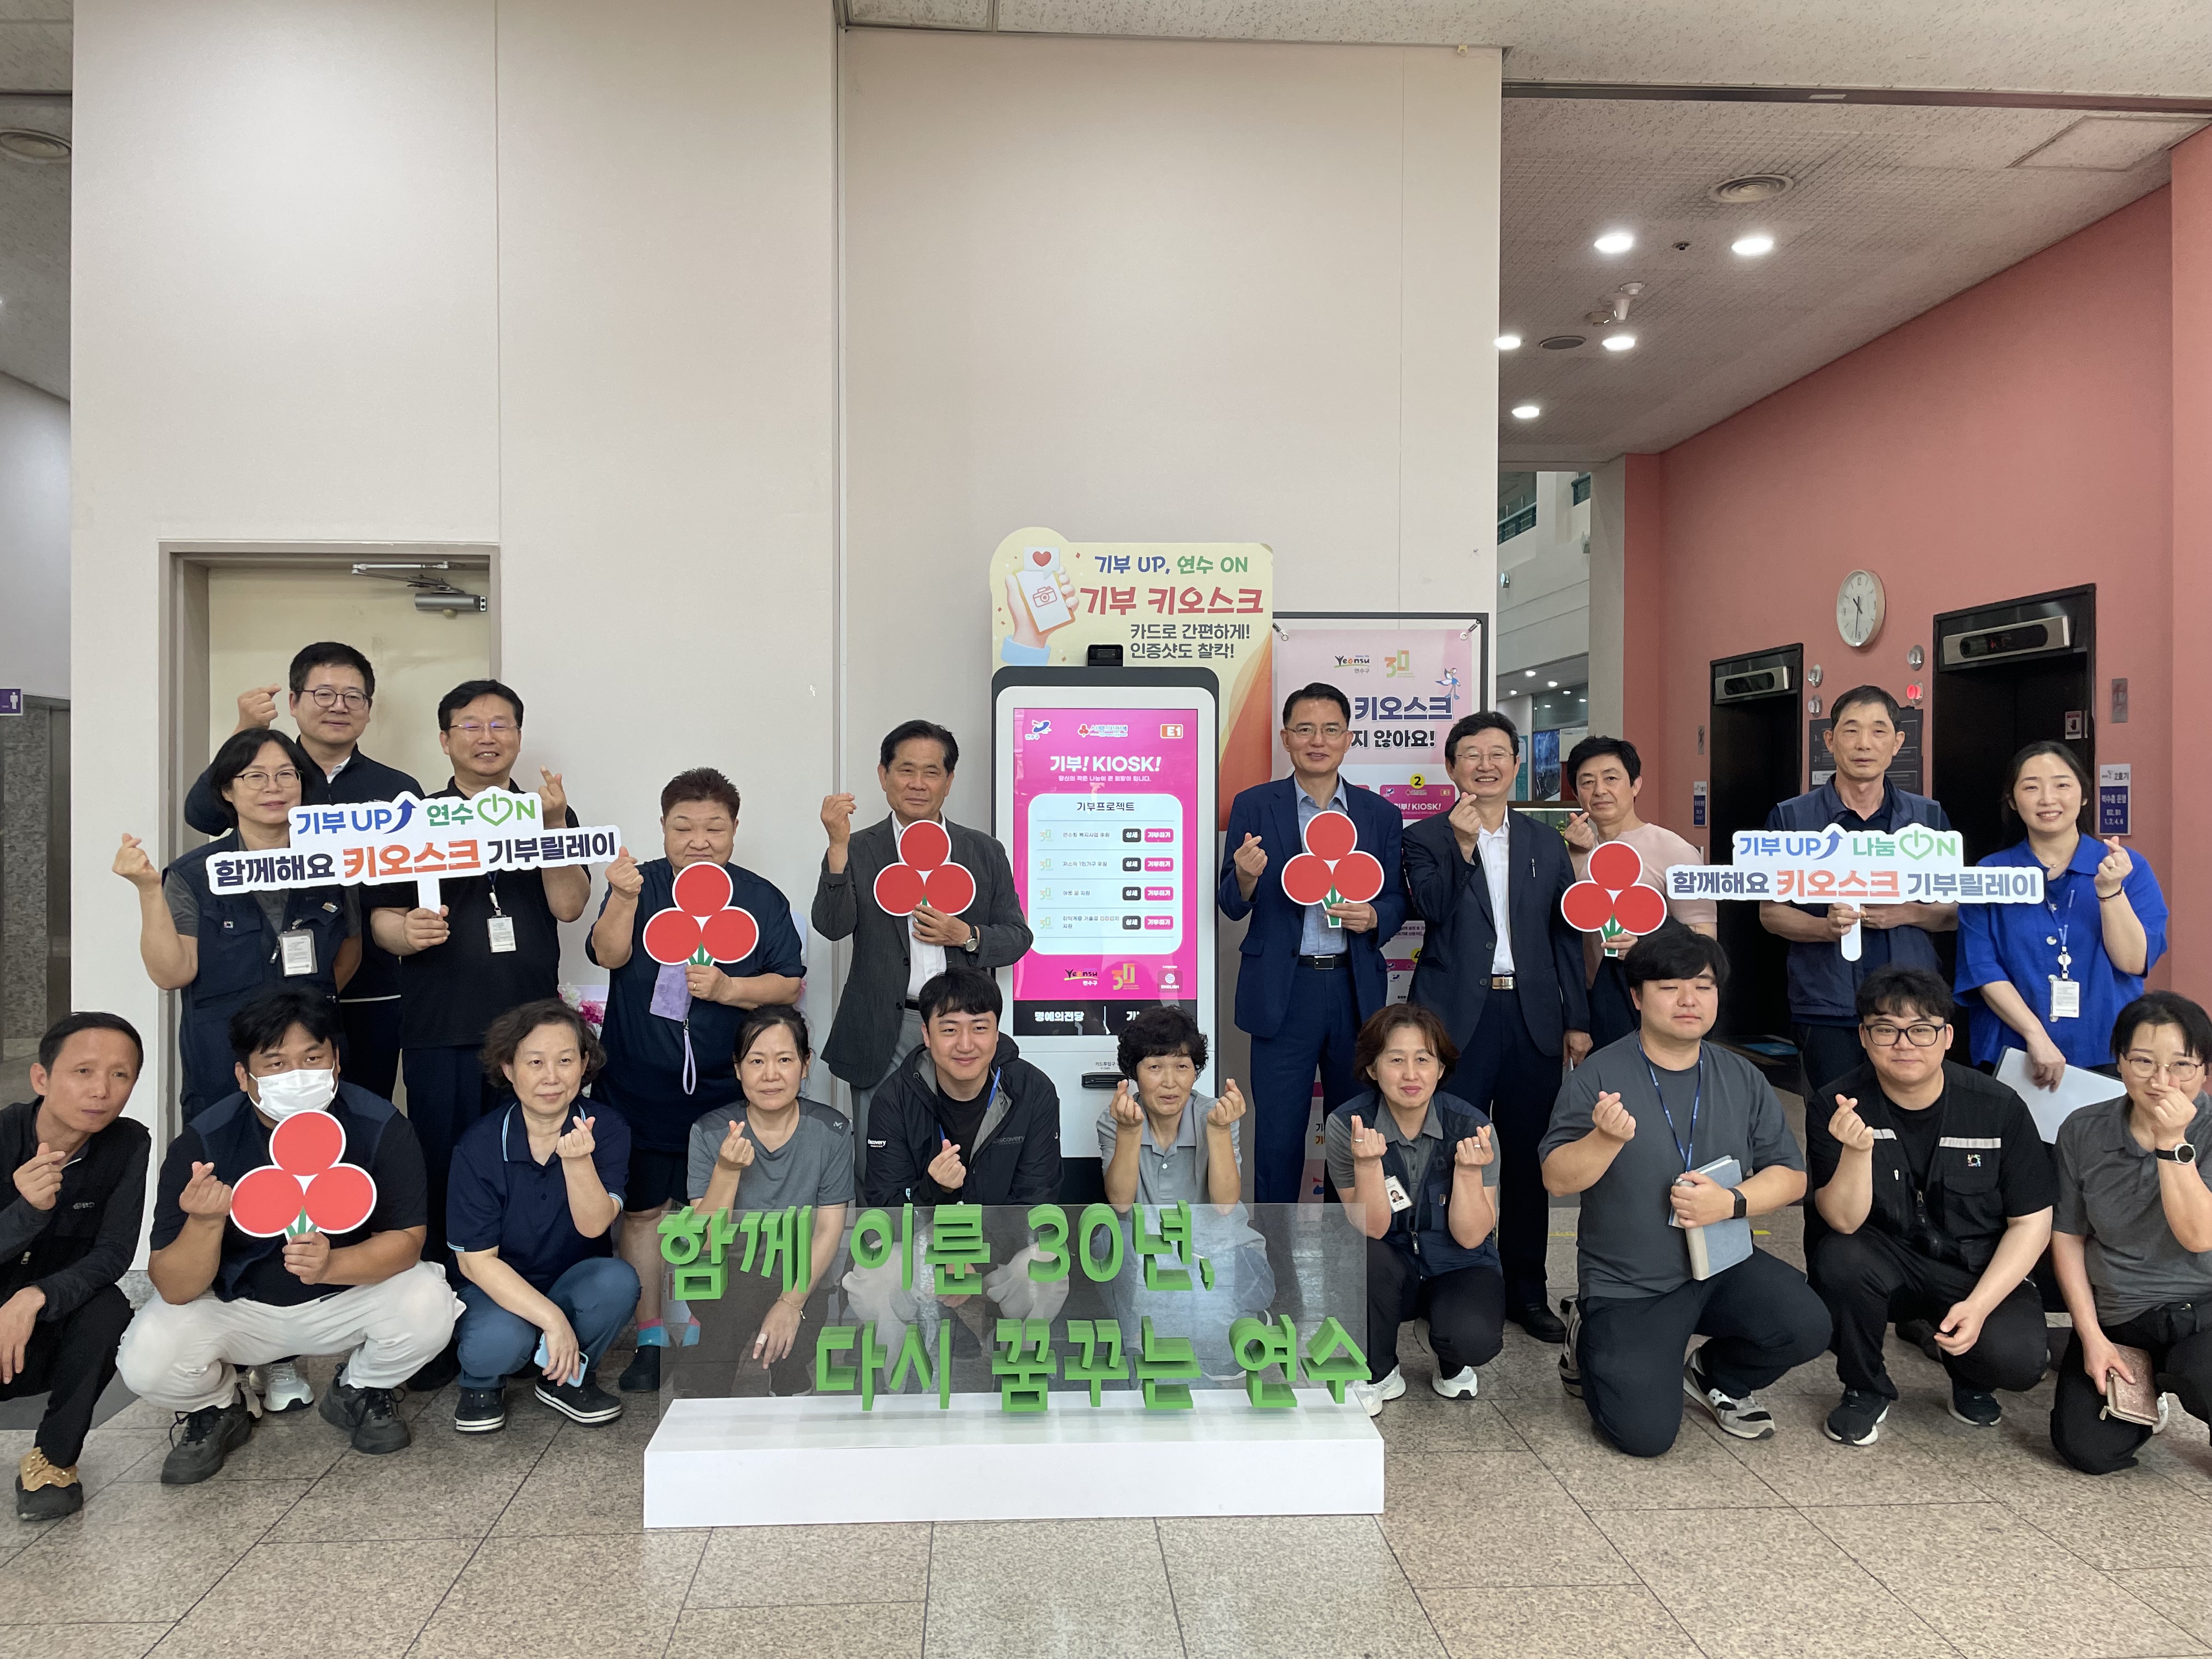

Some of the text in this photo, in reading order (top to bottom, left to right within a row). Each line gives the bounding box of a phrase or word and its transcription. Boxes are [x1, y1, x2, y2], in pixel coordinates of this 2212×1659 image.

[1094, 555, 1248, 575] 기부 UP, 연수 ON
[1080, 586, 1264, 616] 기부 키오스크
[1130, 623, 1251, 640] 카드로 간편하게!
[1130, 642, 1234, 659] 인증샷도 찰칵!
[1334, 655, 1370, 667] Yeonsu
[1355, 696, 1453, 721] 키오스크
[1166, 726, 1182, 737] E1
[1351, 730, 1435, 748] 지 않아요!
[1050, 755, 1162, 772] 기부! KIOSK!
[1414, 776, 1421, 786] 2
[1077, 802, 1135, 812] 기부프로젝트
[1412, 803, 1442, 811] KIOSK!
[296, 810, 348, 836] 기부
[353, 808, 393, 832] UP
[427, 802, 475, 827] 연수
[1739, 836, 1782, 857] 기부
[1785, 837, 1821, 857] UP
[1853, 837, 1895, 857] 나눔
[214, 831, 616, 887] 함께해요 키오스크 기부릴레이
[1672, 868, 2037, 898] 함께해요 키오스크 기부릴레이
[1065, 968, 1097, 979] Yeonsu
[1034, 1011, 1085, 1023] 명예의전당
[657, 1199, 1216, 1301] 함께 이룬 30년,
[815, 1314, 1373, 1412] 다시 꿈꾸는 연수
